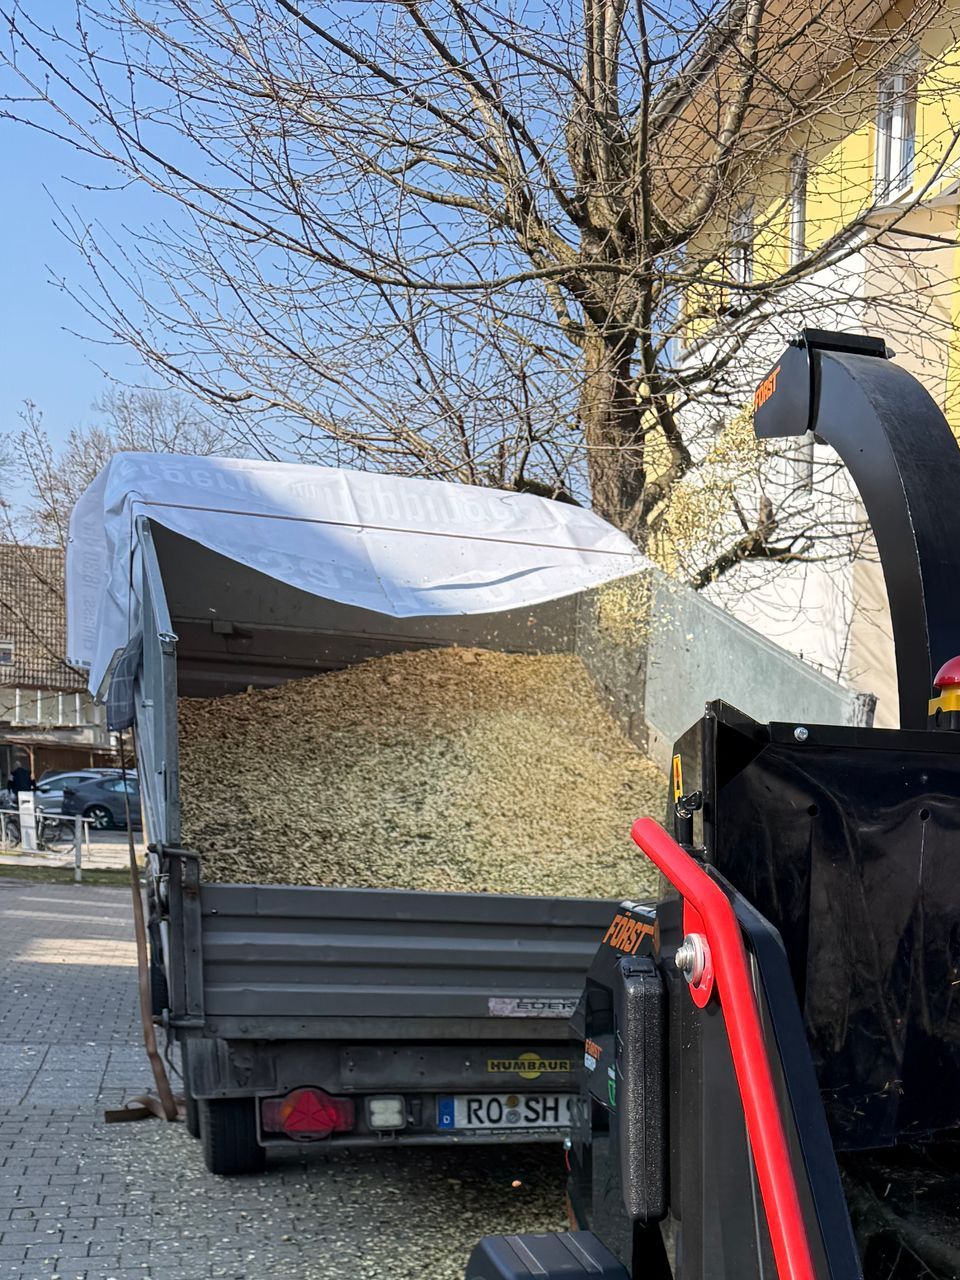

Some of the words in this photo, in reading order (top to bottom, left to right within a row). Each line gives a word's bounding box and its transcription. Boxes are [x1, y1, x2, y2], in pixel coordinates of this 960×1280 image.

[602, 911, 655, 956] FÖRST
[490, 1061, 569, 1071] HUMBAUR
[442, 1115, 450, 1124] D
[466, 1097, 503, 1125] RO
[523, 1096, 560, 1124] SH
